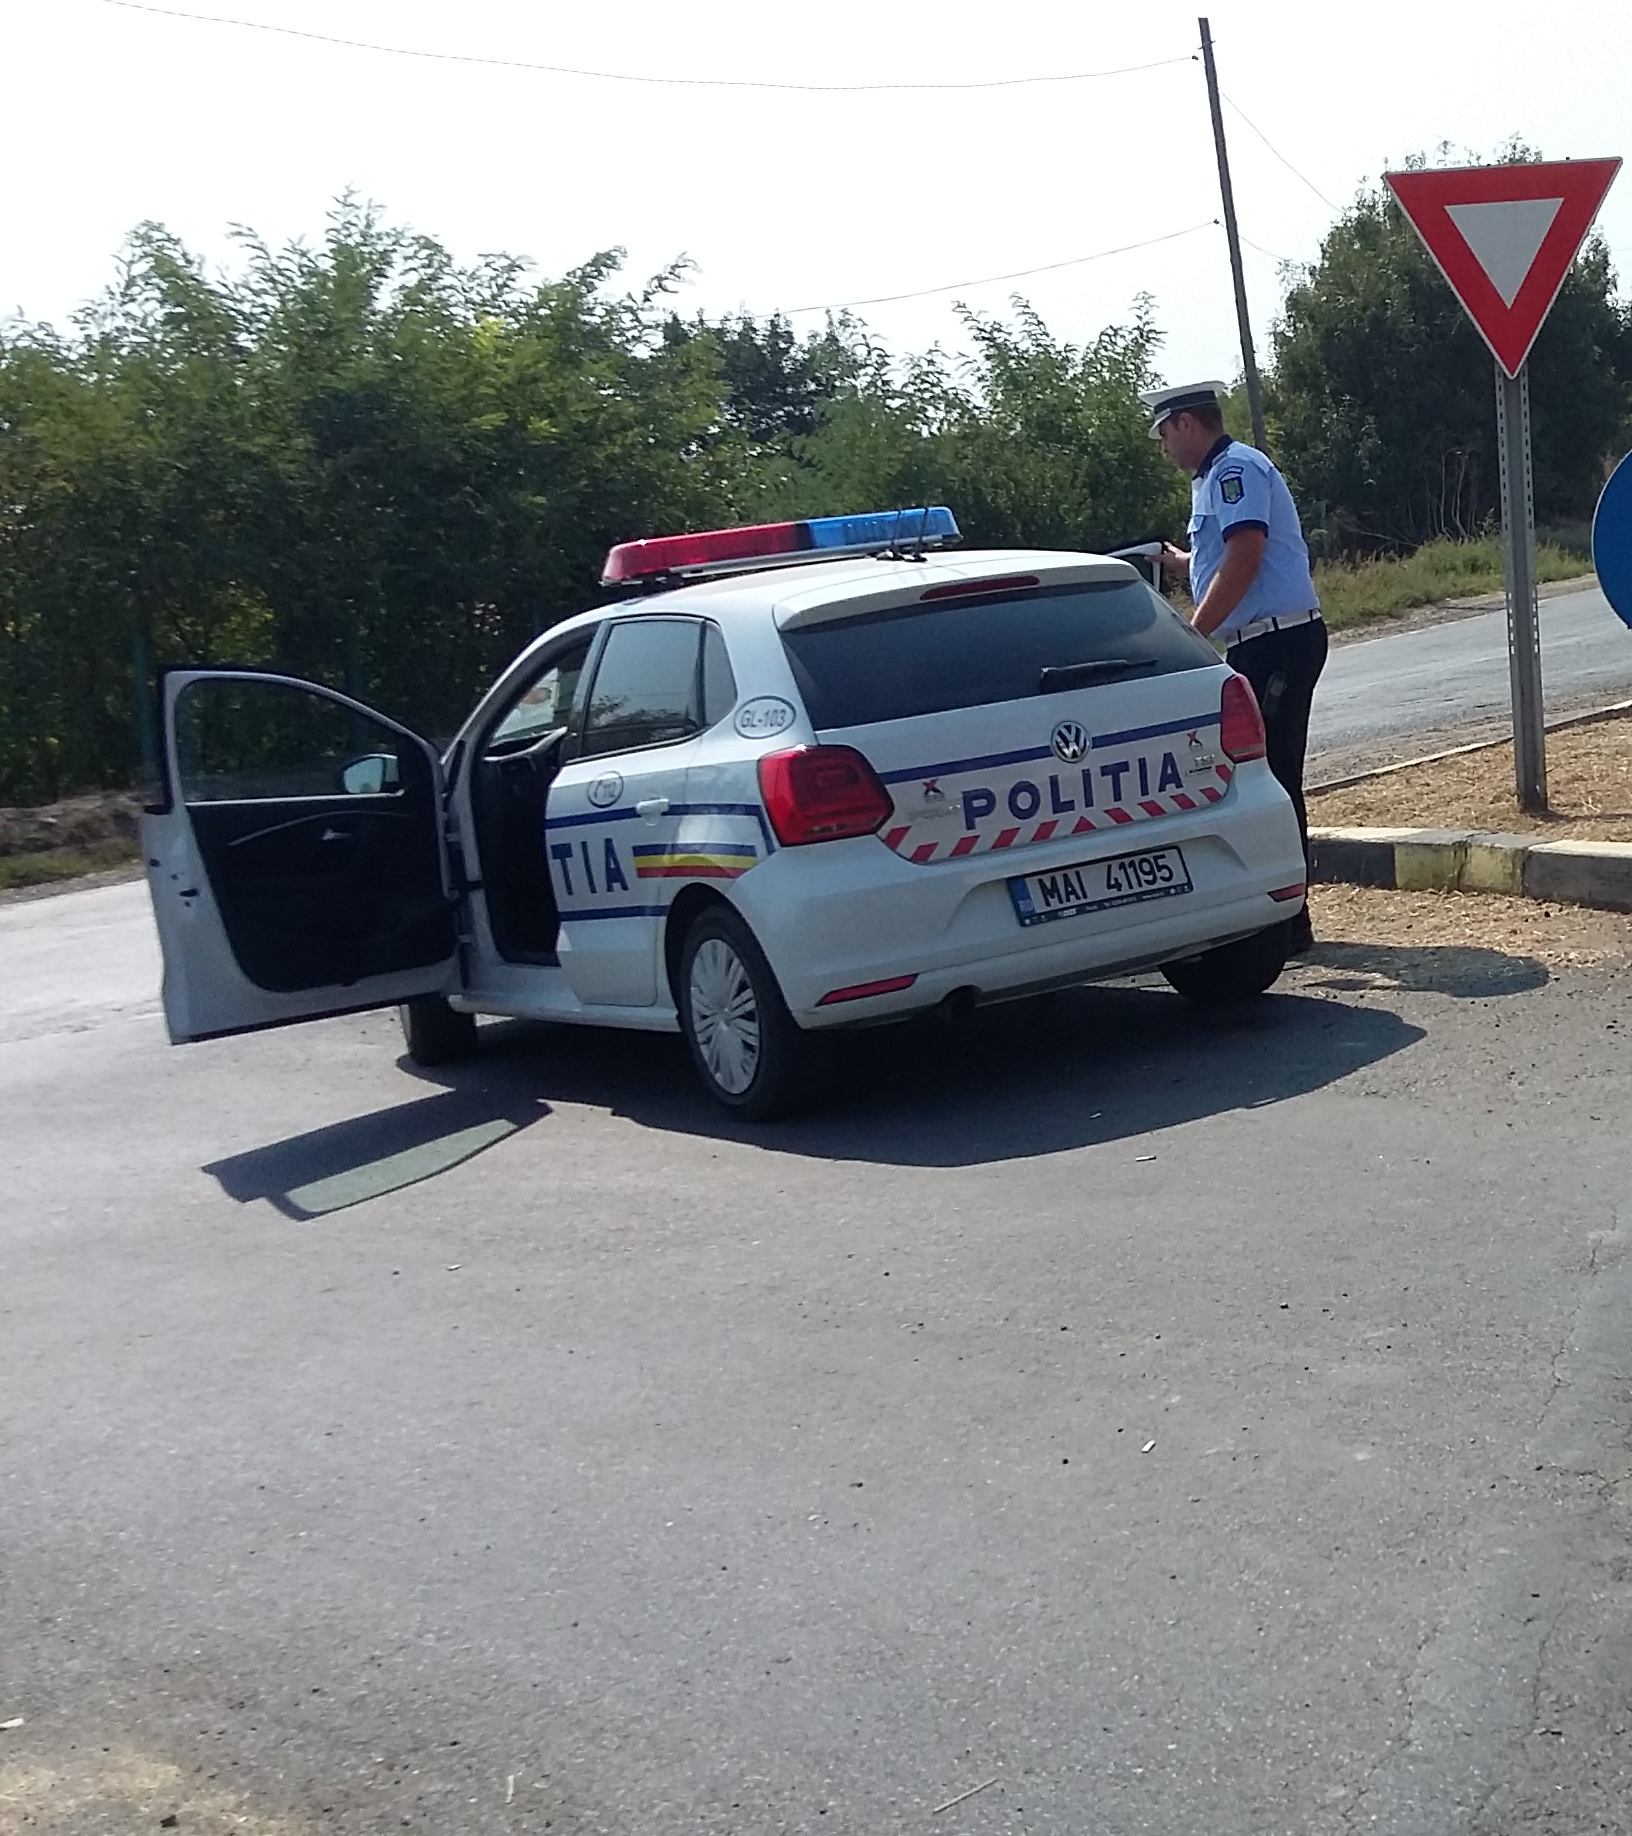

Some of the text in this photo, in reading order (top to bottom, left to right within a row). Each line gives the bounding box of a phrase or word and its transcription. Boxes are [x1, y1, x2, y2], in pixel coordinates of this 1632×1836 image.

[740, 708, 787, 729] GL-103
[961, 751, 1184, 831] POLITIA
[551, 837, 629, 896] TIA
[1037, 870, 1088, 907] MAI
[1106, 853, 1174, 892] 41195
